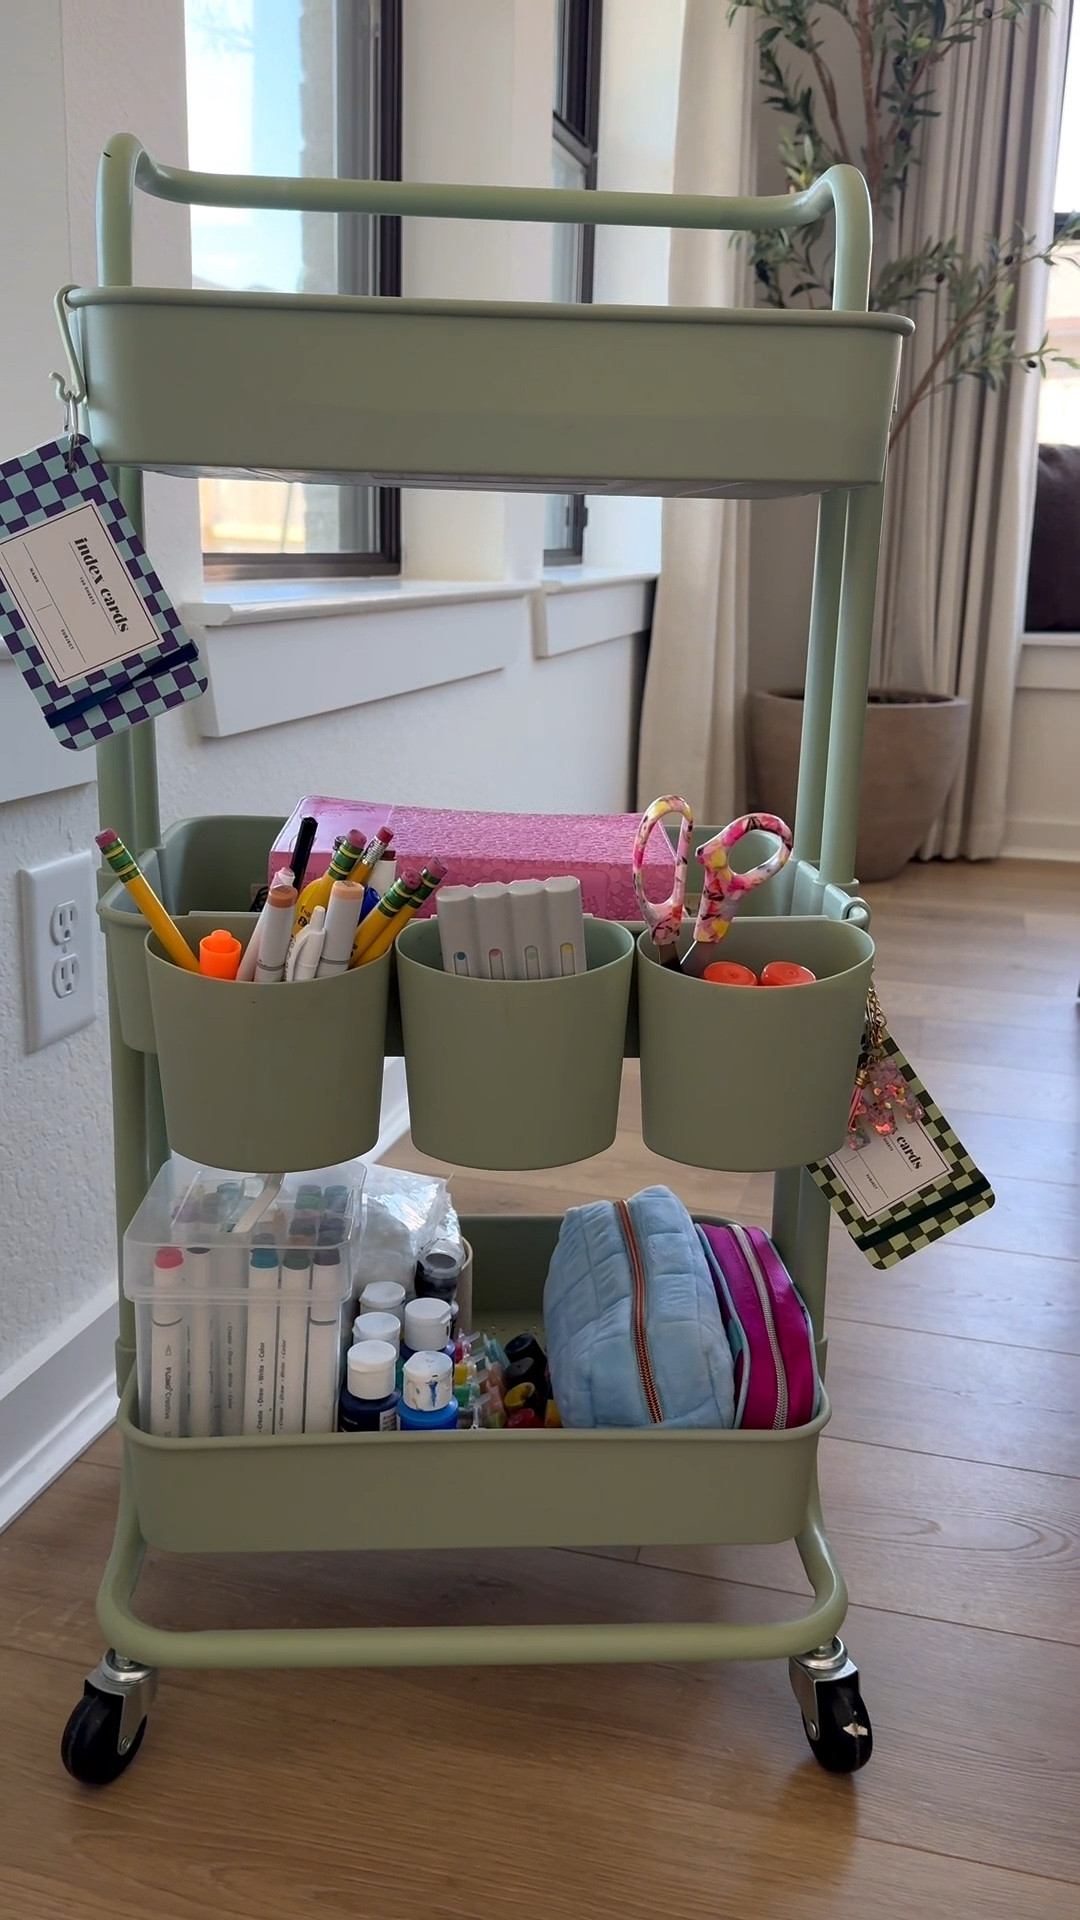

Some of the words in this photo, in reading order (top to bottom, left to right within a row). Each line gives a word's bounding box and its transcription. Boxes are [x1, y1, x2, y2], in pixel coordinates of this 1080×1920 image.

[29, 567, 40, 583] NAME
[74, 537, 105, 585] index
[100, 588, 129, 633] cards
[61, 629, 75, 650] SUBJECT
[896, 1136, 923, 1170] cards
